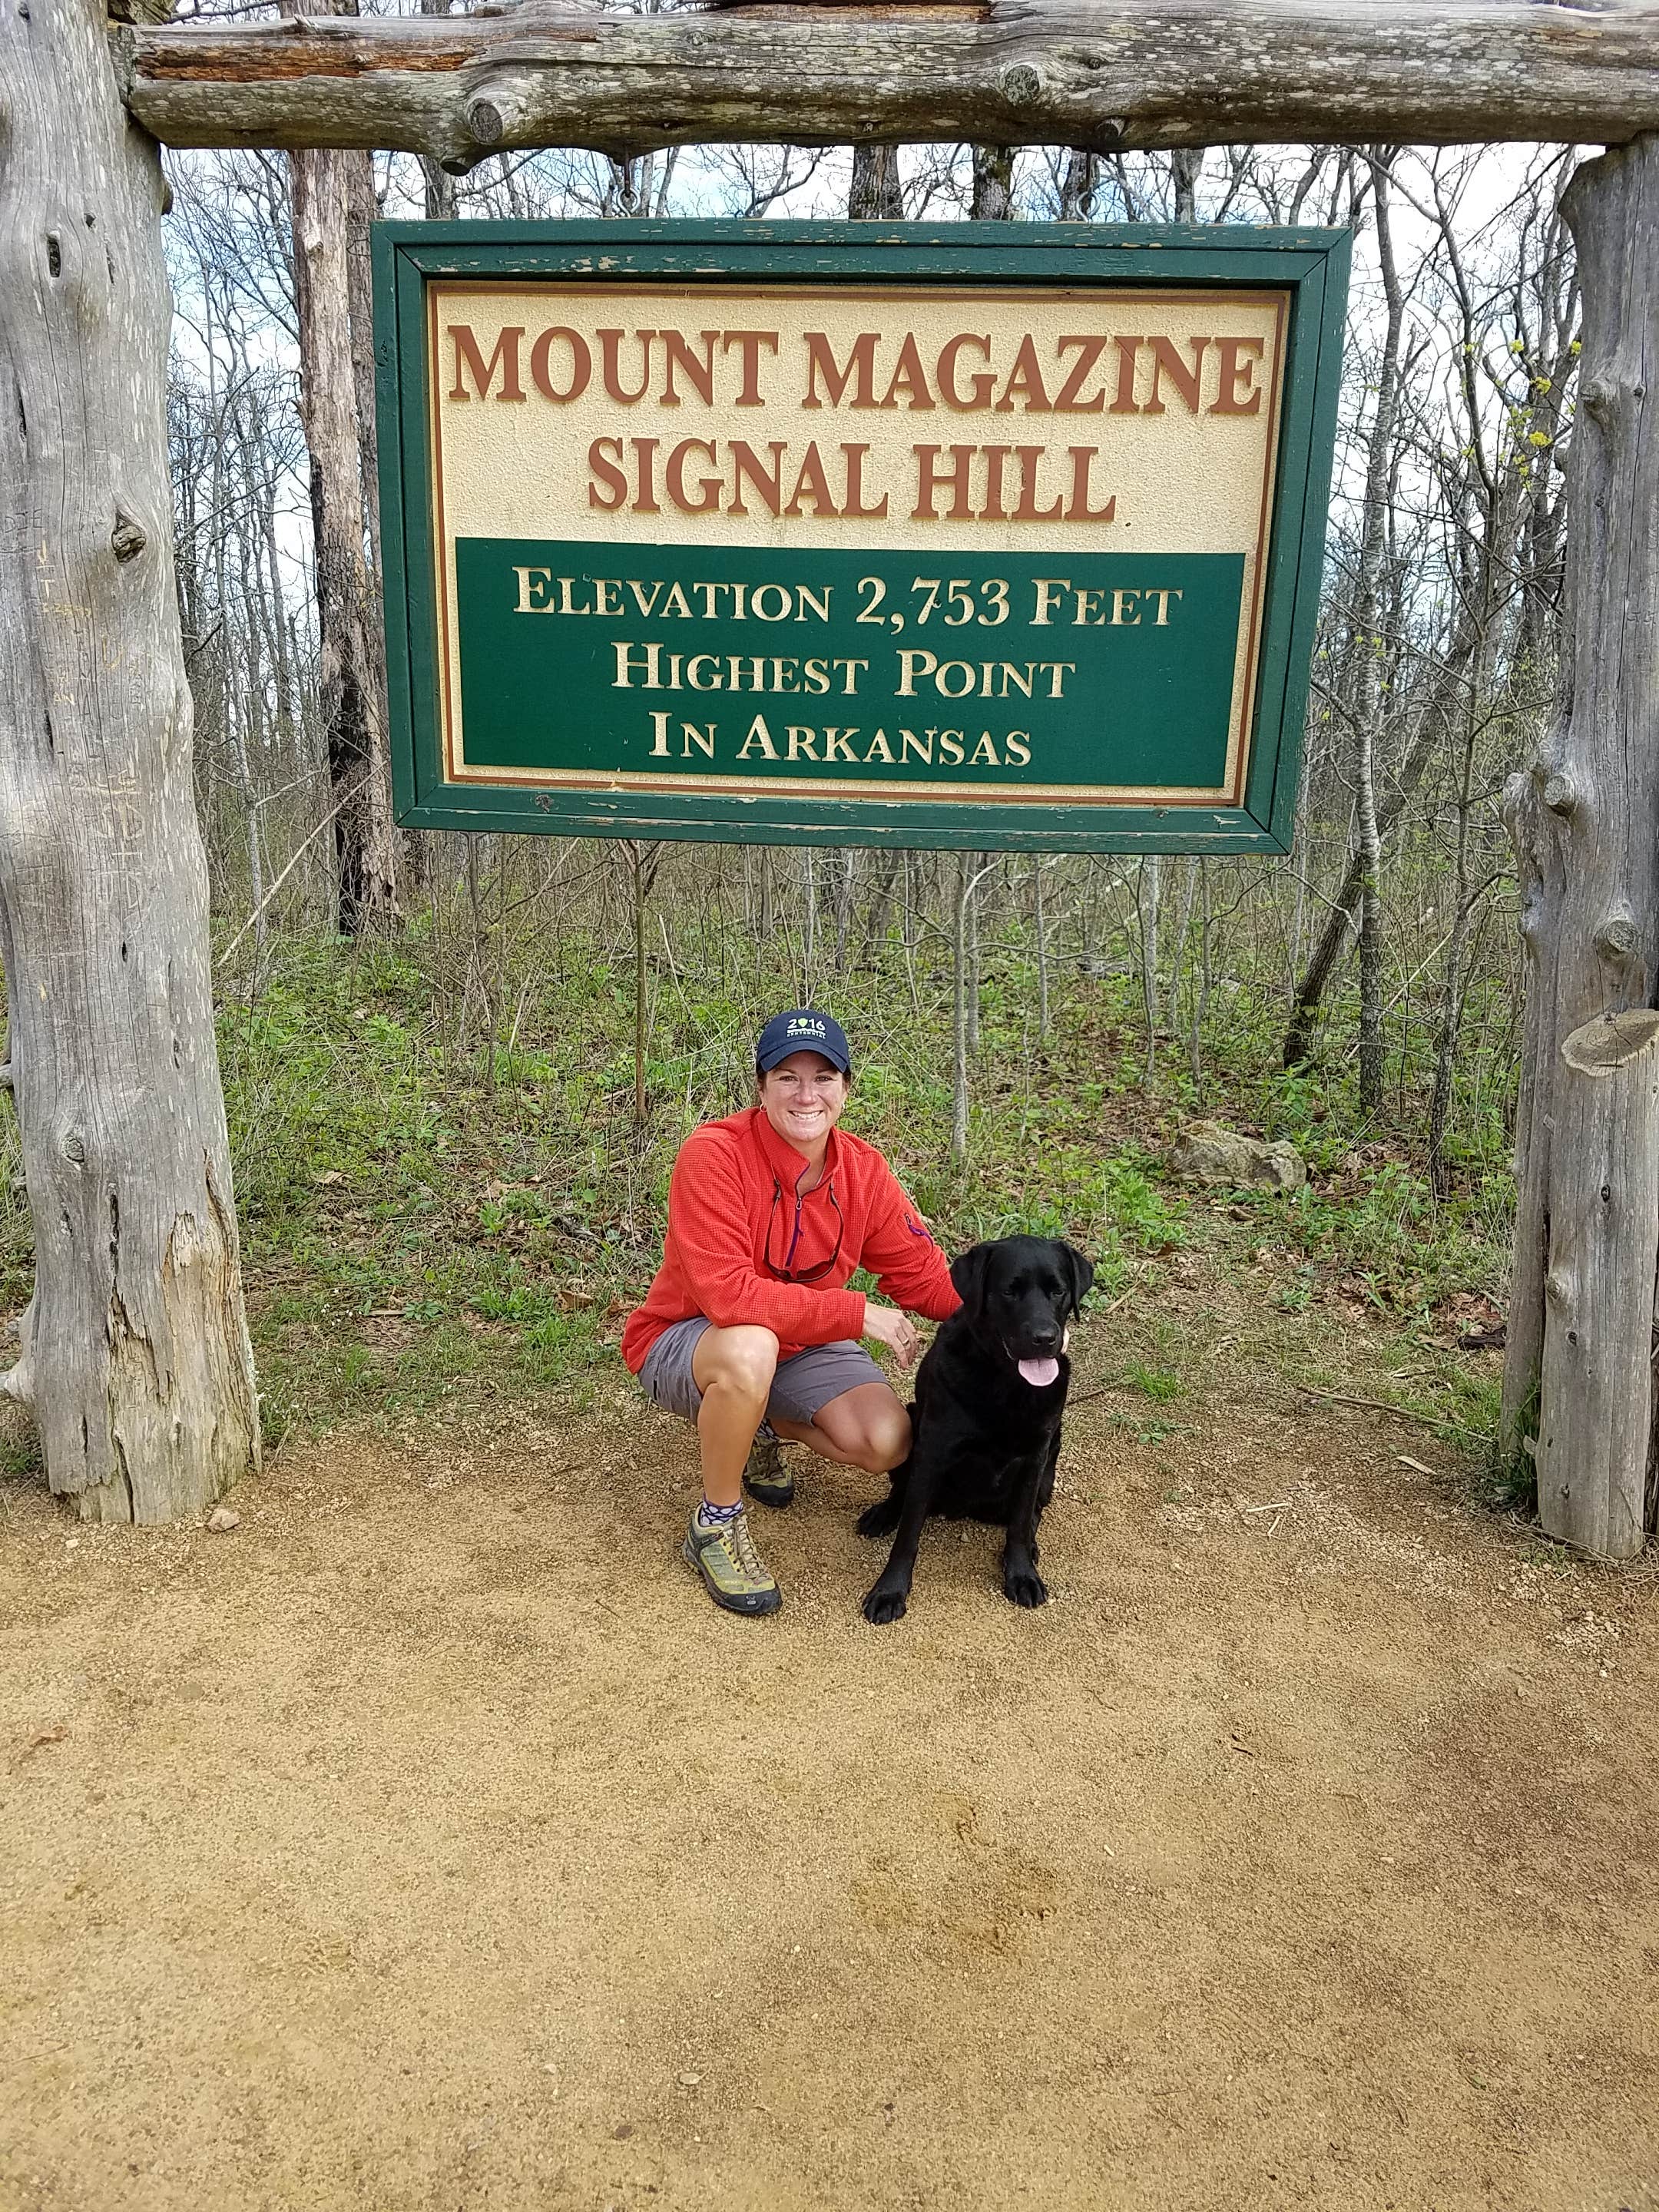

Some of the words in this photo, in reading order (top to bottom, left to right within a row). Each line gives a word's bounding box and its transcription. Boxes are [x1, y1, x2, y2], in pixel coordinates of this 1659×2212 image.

[448, 325, 779, 406] MOUNT
[803, 332, 1264, 416] MAGAZINE
[589, 436, 889, 518] SIGNAL
[911, 444, 1117, 523] HILL
[512, 566, 833, 624] ELEVATION
[855, 576, 1011, 636] 2,753
[1028, 579, 1184, 627] FEET
[611, 641, 869, 695] HIGHEST
[894, 649, 1076, 699] POINT
[648, 711, 717, 760] IN
[735, 714, 1032, 767] ARKANSAS
